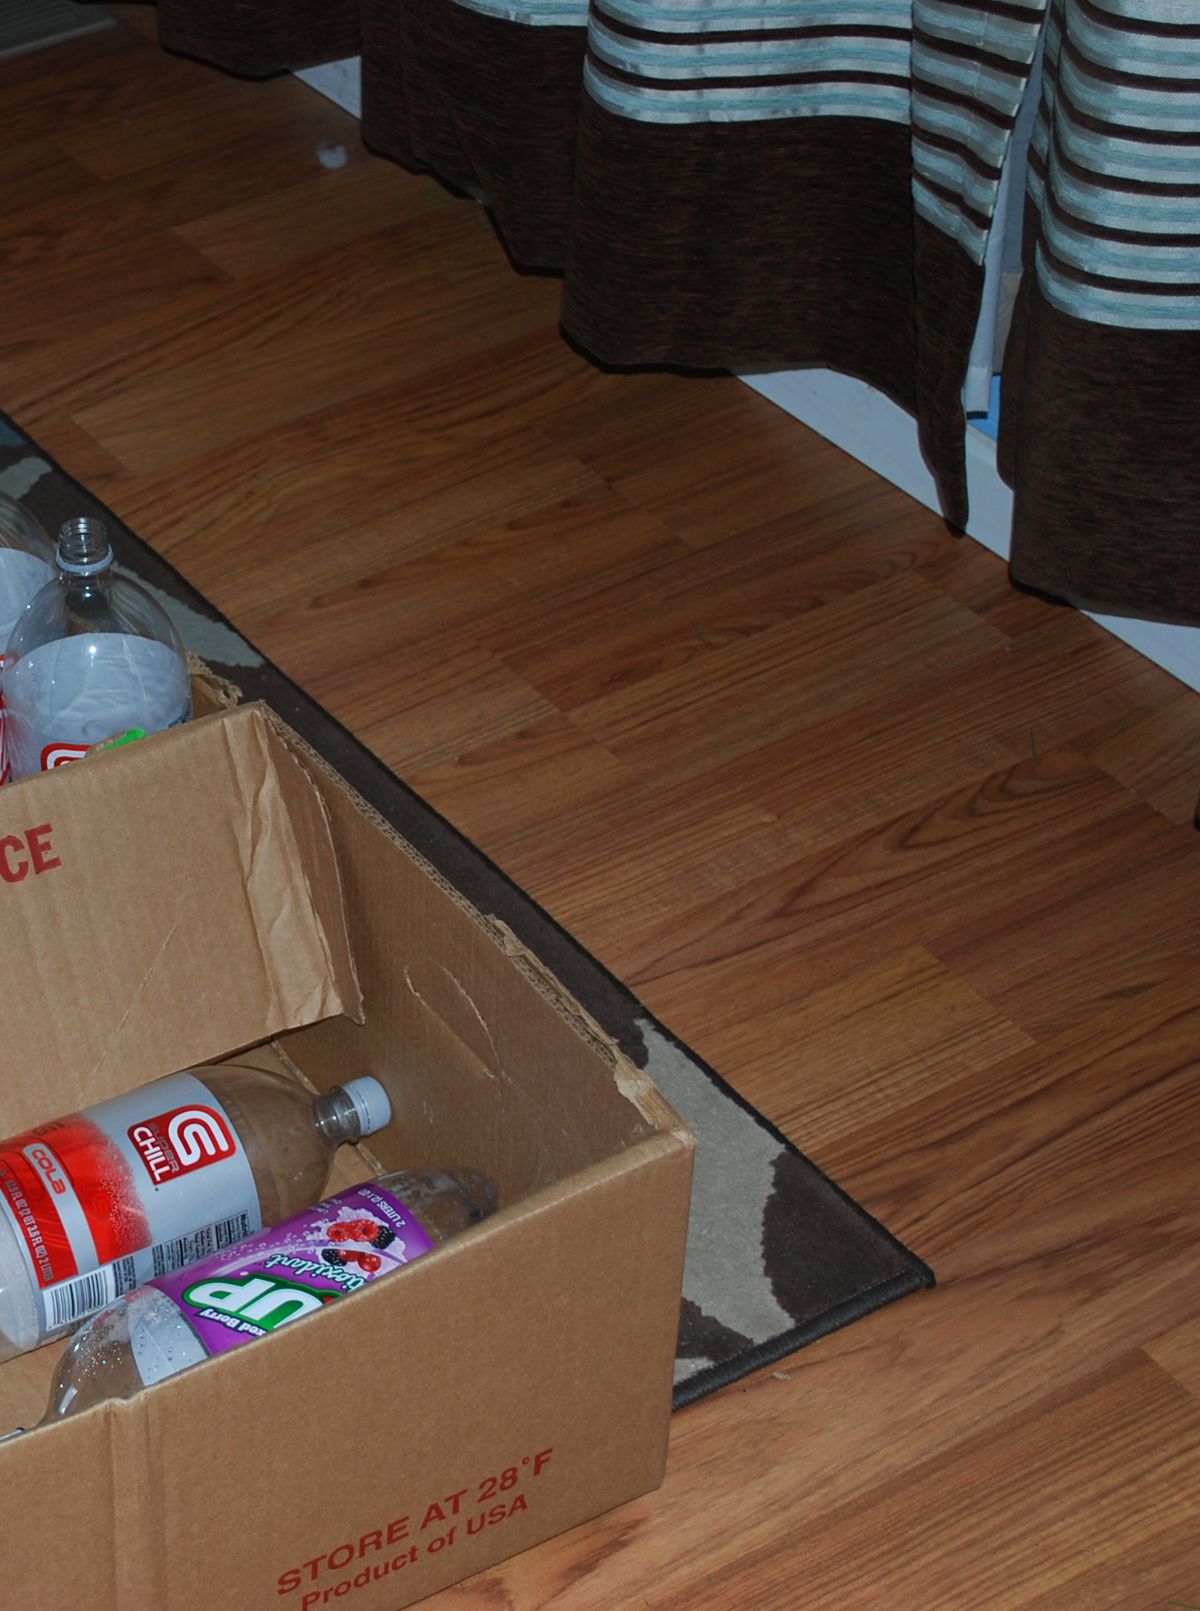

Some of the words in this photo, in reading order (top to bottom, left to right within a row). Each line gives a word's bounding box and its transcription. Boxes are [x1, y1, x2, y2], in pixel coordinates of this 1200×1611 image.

[31, 1149, 67, 1195] COLA
[133, 1126, 170, 1182] CHILL
[264, 1253, 366, 1293] tioxidant
[188, 1277, 324, 1328] UP
[199, 1308, 241, 1329] Berry
[277, 1515, 410, 1595] STORE
[419, 1489, 468, 1530] AT
[477, 1448, 554, 1503] 28°F
[301, 1545, 419, 1611] Product
[427, 1526, 457, 1554] of
[466, 1494, 528, 1536] USA
